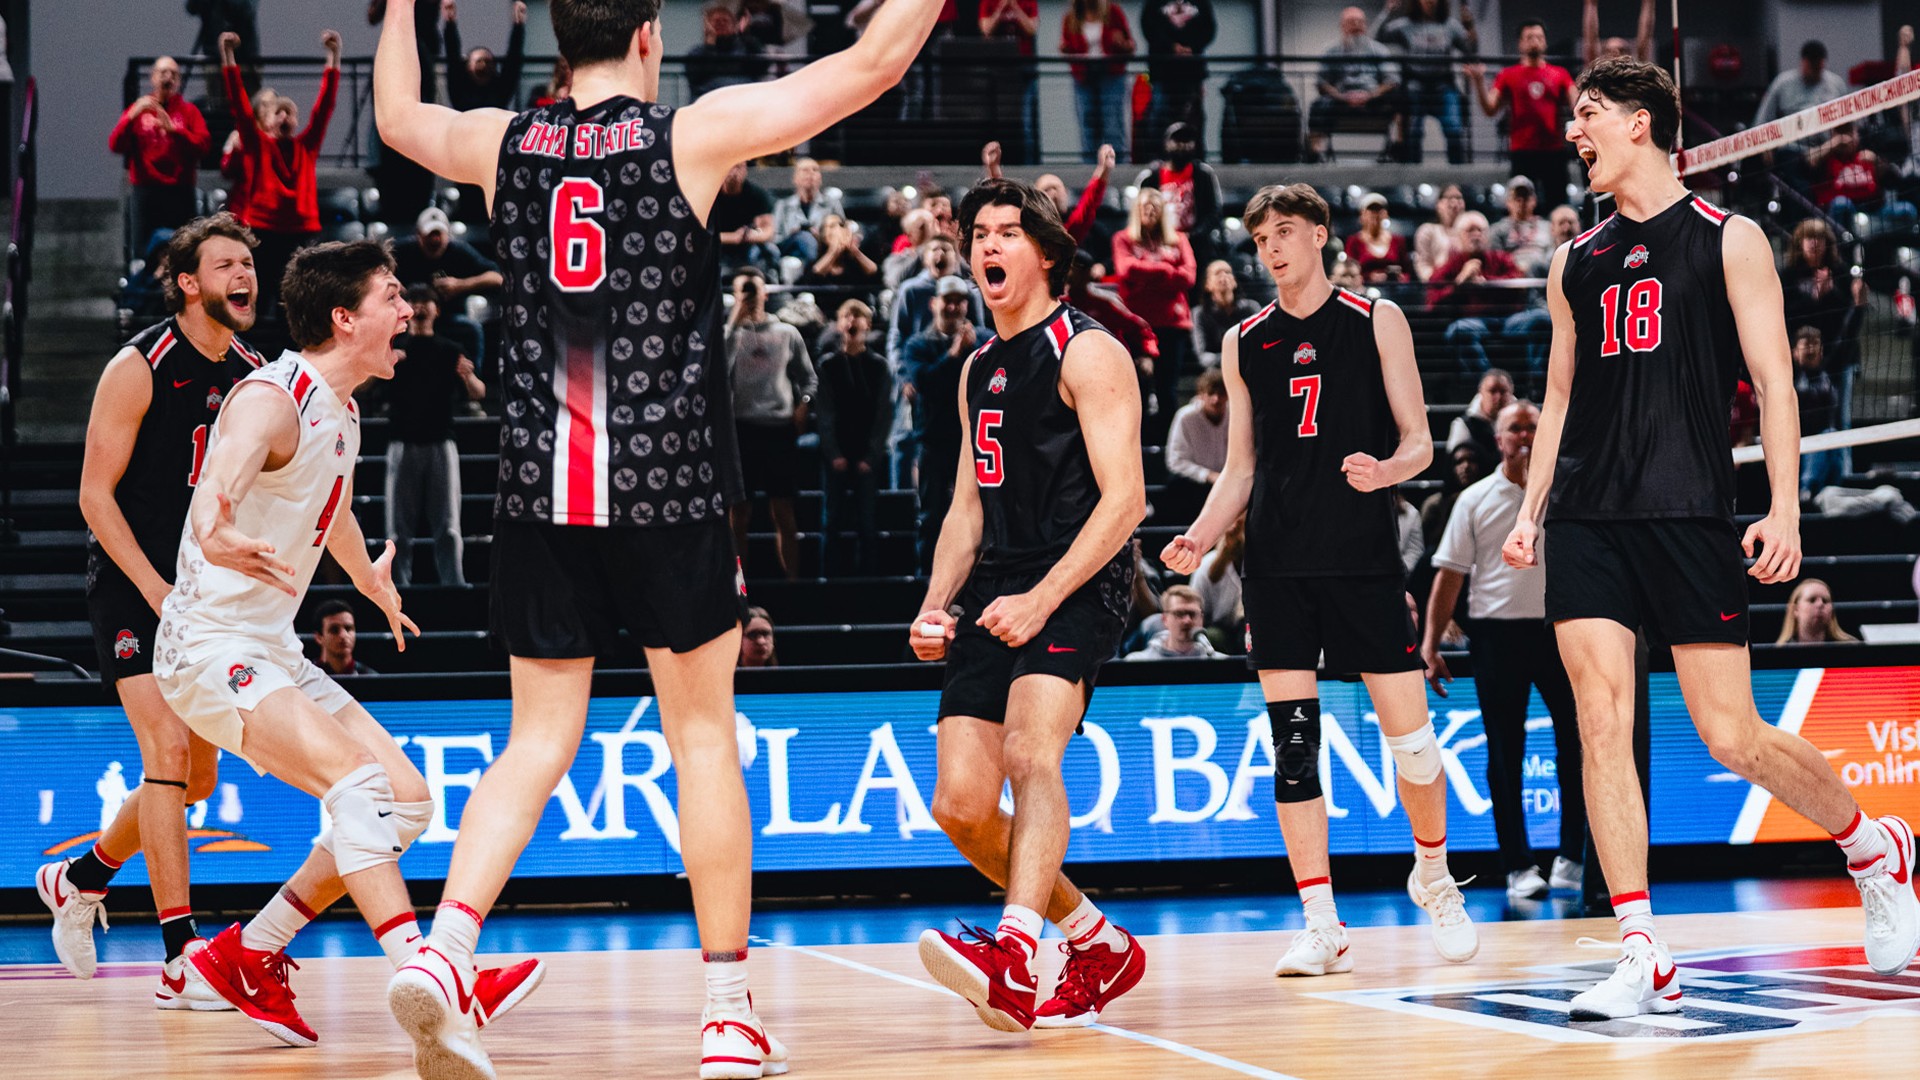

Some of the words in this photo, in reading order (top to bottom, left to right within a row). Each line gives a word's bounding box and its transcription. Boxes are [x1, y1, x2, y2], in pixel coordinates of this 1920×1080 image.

[520, 122, 568, 160] OHO
[575, 118, 643, 159] STATE
[549, 176, 607, 293] 6
[1601, 277, 1662, 358] 18
[1290, 374, 1321, 437] 7
[188, 424, 213, 487] 1
[976, 409, 1005, 487] 5
[312, 475, 344, 547] 4
